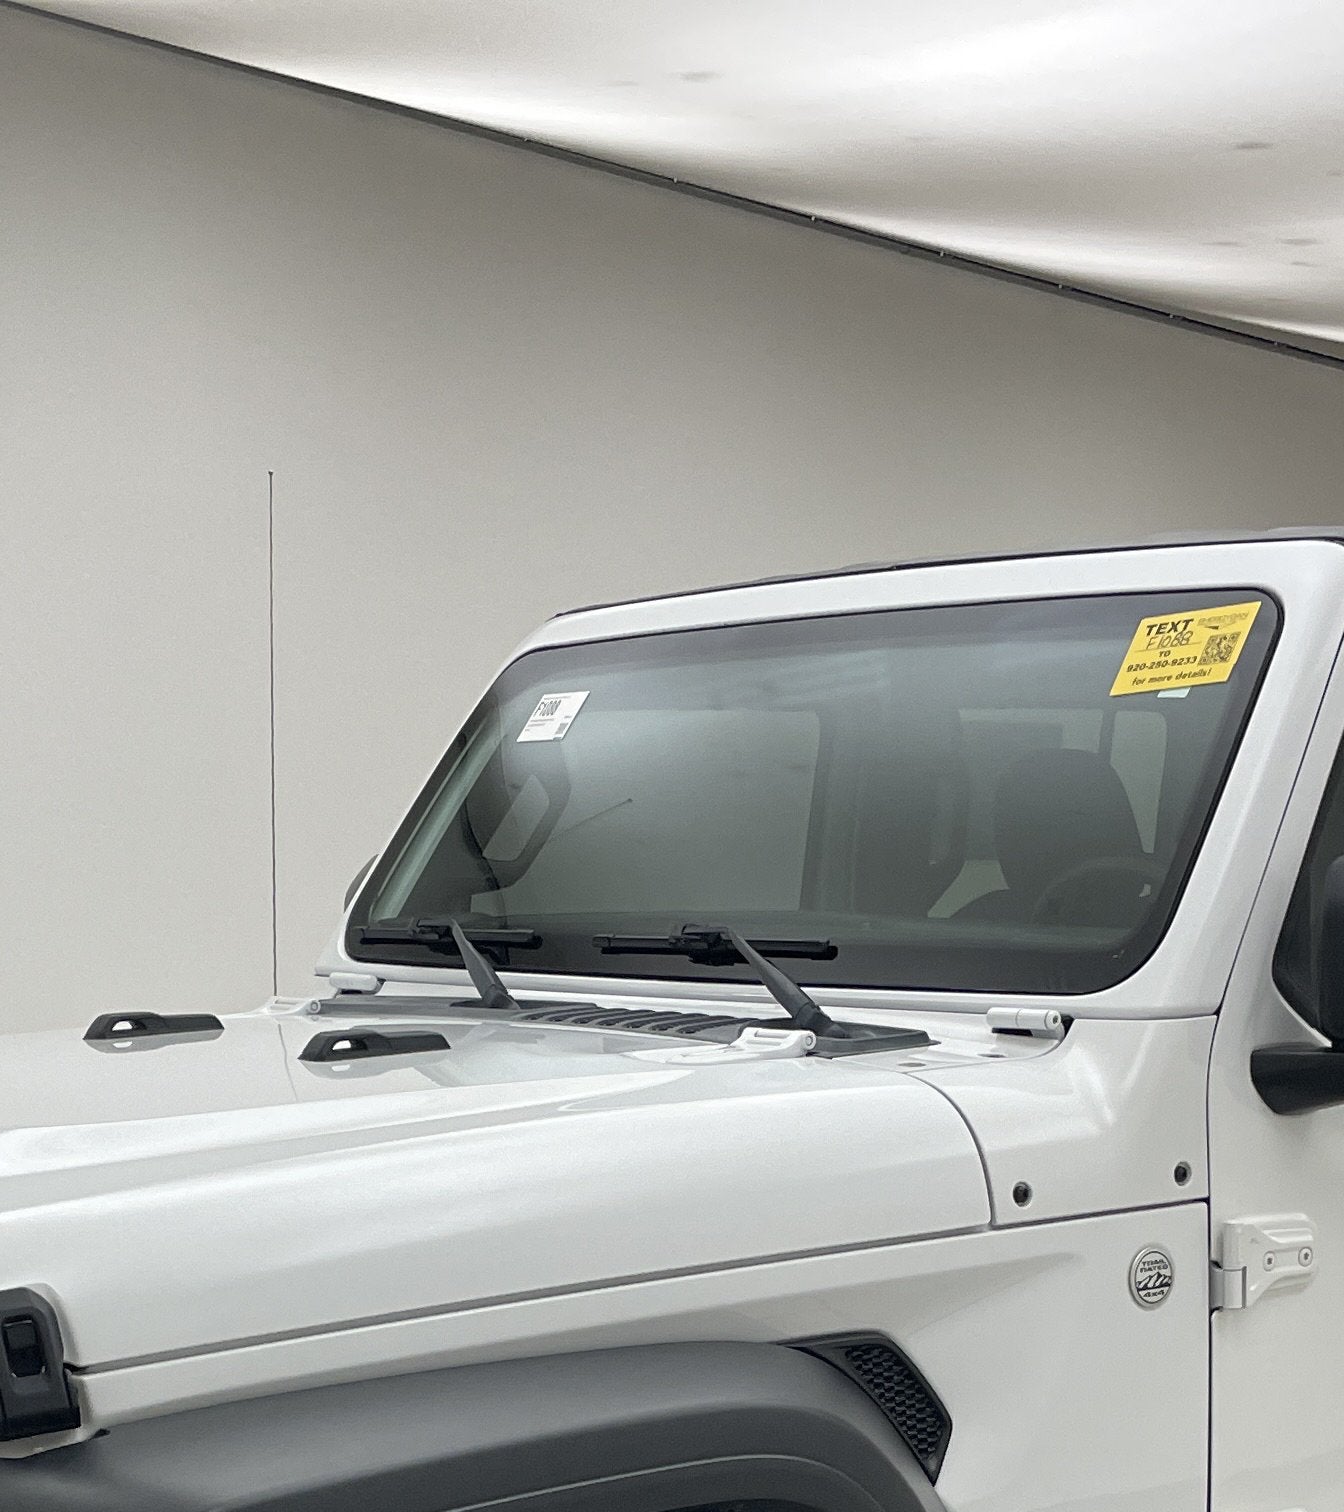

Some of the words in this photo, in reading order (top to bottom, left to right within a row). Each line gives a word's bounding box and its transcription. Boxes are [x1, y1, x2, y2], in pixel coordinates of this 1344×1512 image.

[1146, 618, 1195, 637] TEXT
[1159, 650, 1171, 658] TO
[1131, 676, 1146, 686] for
[1148, 675, 1172, 684] more
[1174, 667, 1213, 680] details!
